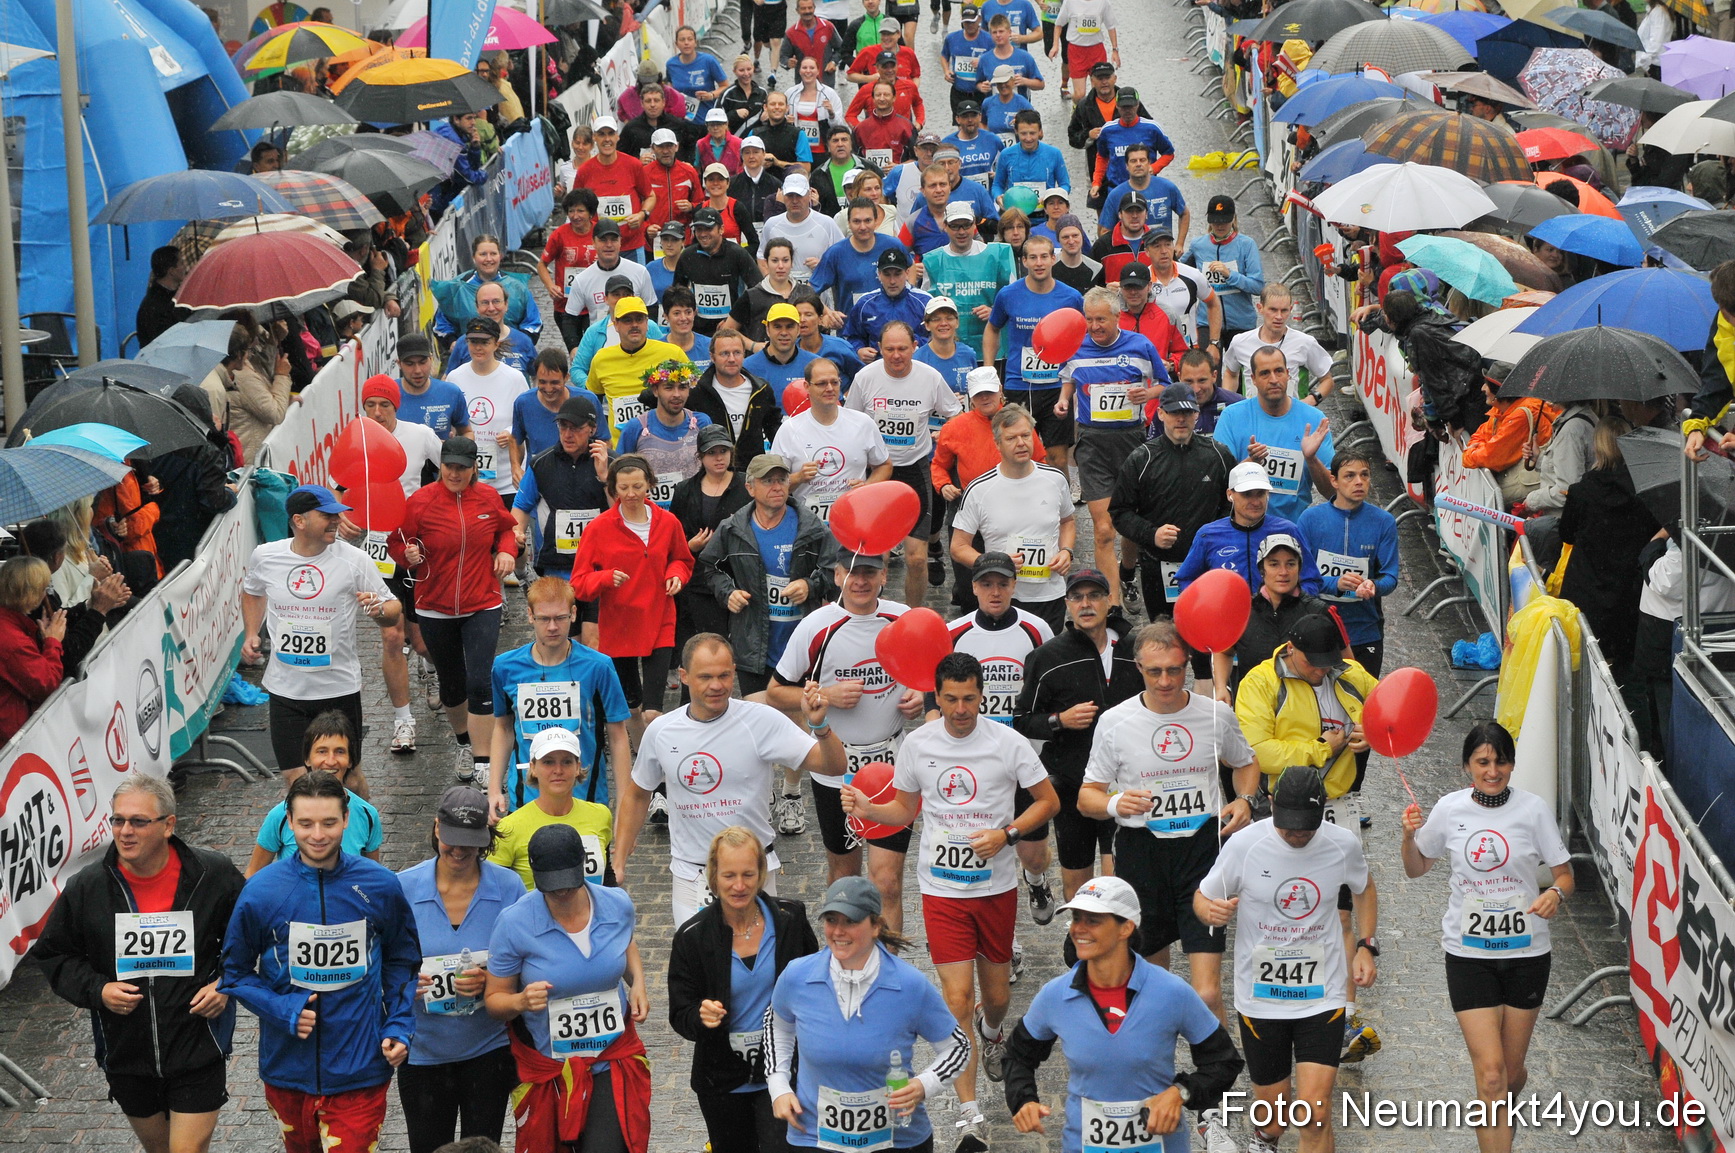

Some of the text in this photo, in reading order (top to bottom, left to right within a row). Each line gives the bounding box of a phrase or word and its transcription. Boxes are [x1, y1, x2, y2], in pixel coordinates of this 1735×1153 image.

[1081, 19, 1097, 28] 805
[603, 203, 626, 216] 496
[955, 281, 998, 290] RUNNERS
[955, 288, 983, 297] POINT
[698, 293, 727, 307] 2957
[887, 398, 922, 408] Egner
[1099, 395, 1126, 411] 677
[878, 419, 916, 436] 2390
[477, 454, 494, 470] 37
[1269, 480, 1284, 488] rank
[810, 504, 829, 521] 27
[1442, 495, 1499, 521] ReiseCenter
[1016, 547, 1046, 566] 570
[273, 603, 338, 613] LAUFEN MIT HERZ
[768, 607, 795, 617] olfgang
[280, 633, 327, 655] 2928
[293, 656, 311, 666] Jack
[834, 666, 890, 678] GERHAR
[137, 695, 161, 725] NISSAN
[523, 696, 574, 720] 2881
[979, 695, 1017, 715] 324
[547, 733, 568, 742] GAP
[1140, 765, 1208, 779] LAUFEN MIT HERZ
[46, 792, 55, 815] &
[674, 798, 743, 812] LAUFEN MIT HERZ
[1151, 789, 1206, 818] 2444
[706, 810, 715, 818] Dr.
[715, 808, 737, 818] Röschl
[956, 812, 971, 820] MIT
[972, 811, 994, 820] HERZ
[1169, 819, 1190, 830] Rudi
[81, 812, 112, 854] SEAT
[941, 870, 981, 884] Johannes
[1485, 877, 1500, 886] MIT
[1502, 874, 1523, 885] HERZ
[1258, 921, 1325, 934] LAUFEN MIT HERZ
[1468, 910, 1526, 936] 2446
[123, 929, 188, 957] 2972
[1484, 938, 1509, 949] Doris
[296, 939, 360, 967] 3025
[133, 958, 176, 970] Joachim
[303, 970, 352, 983] Johannes
[1259, 960, 1319, 985] 2447
[1270, 986, 1308, 999] Michael
[557, 1006, 618, 1039] 3316
[570, 1037, 608, 1051] Martina
[824, 1104, 888, 1133] 3028
[1089, 1115, 1154, 1146] 3243
[841, 1134, 869, 1147] Linda
